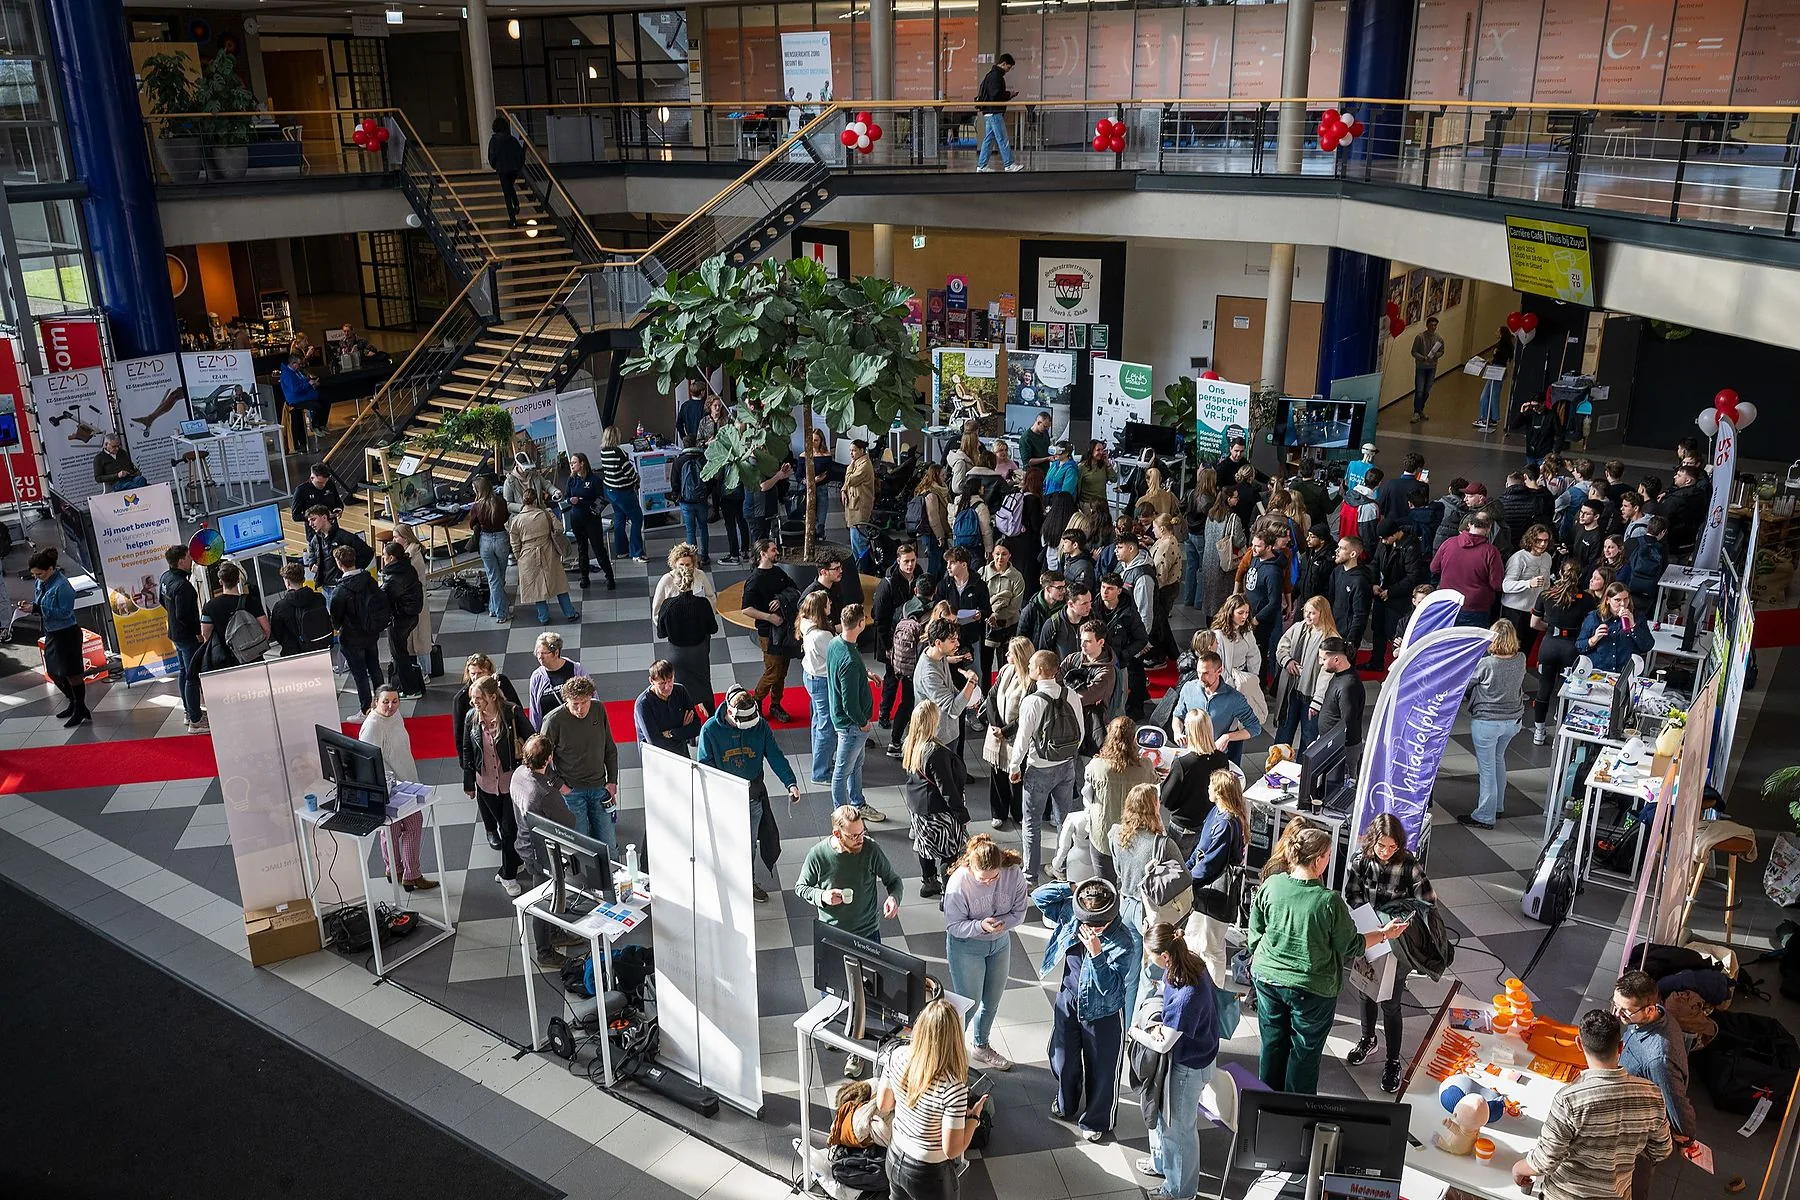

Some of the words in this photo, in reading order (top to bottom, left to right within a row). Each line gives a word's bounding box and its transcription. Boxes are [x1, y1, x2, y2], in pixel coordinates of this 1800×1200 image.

[1531, 230, 1543, 240] Café
[1547, 233, 1561, 244] Thuis
[1570, 236, 1584, 248] Zuyd
[50, 326, 73, 372] om
[1208, 384, 1225, 394] Ons
[515, 398, 552, 415] CORPUSVR
[1198, 394, 1247, 407] perspectief
[1204, 410, 1235, 423] VR-bril
[1206, 403, 1225, 412] door
[1227, 406, 1238, 415] de
[102, 528, 112, 536] Jij
[113, 525, 134, 534] moet
[135, 518, 170, 529] bewegen
[126, 539, 154, 550] helpen
[1369, 688, 1449, 814] Philadelphia
[853, 939, 880, 956] ViewSonic
[1305, 1100, 1346, 1113] ViewSonic
